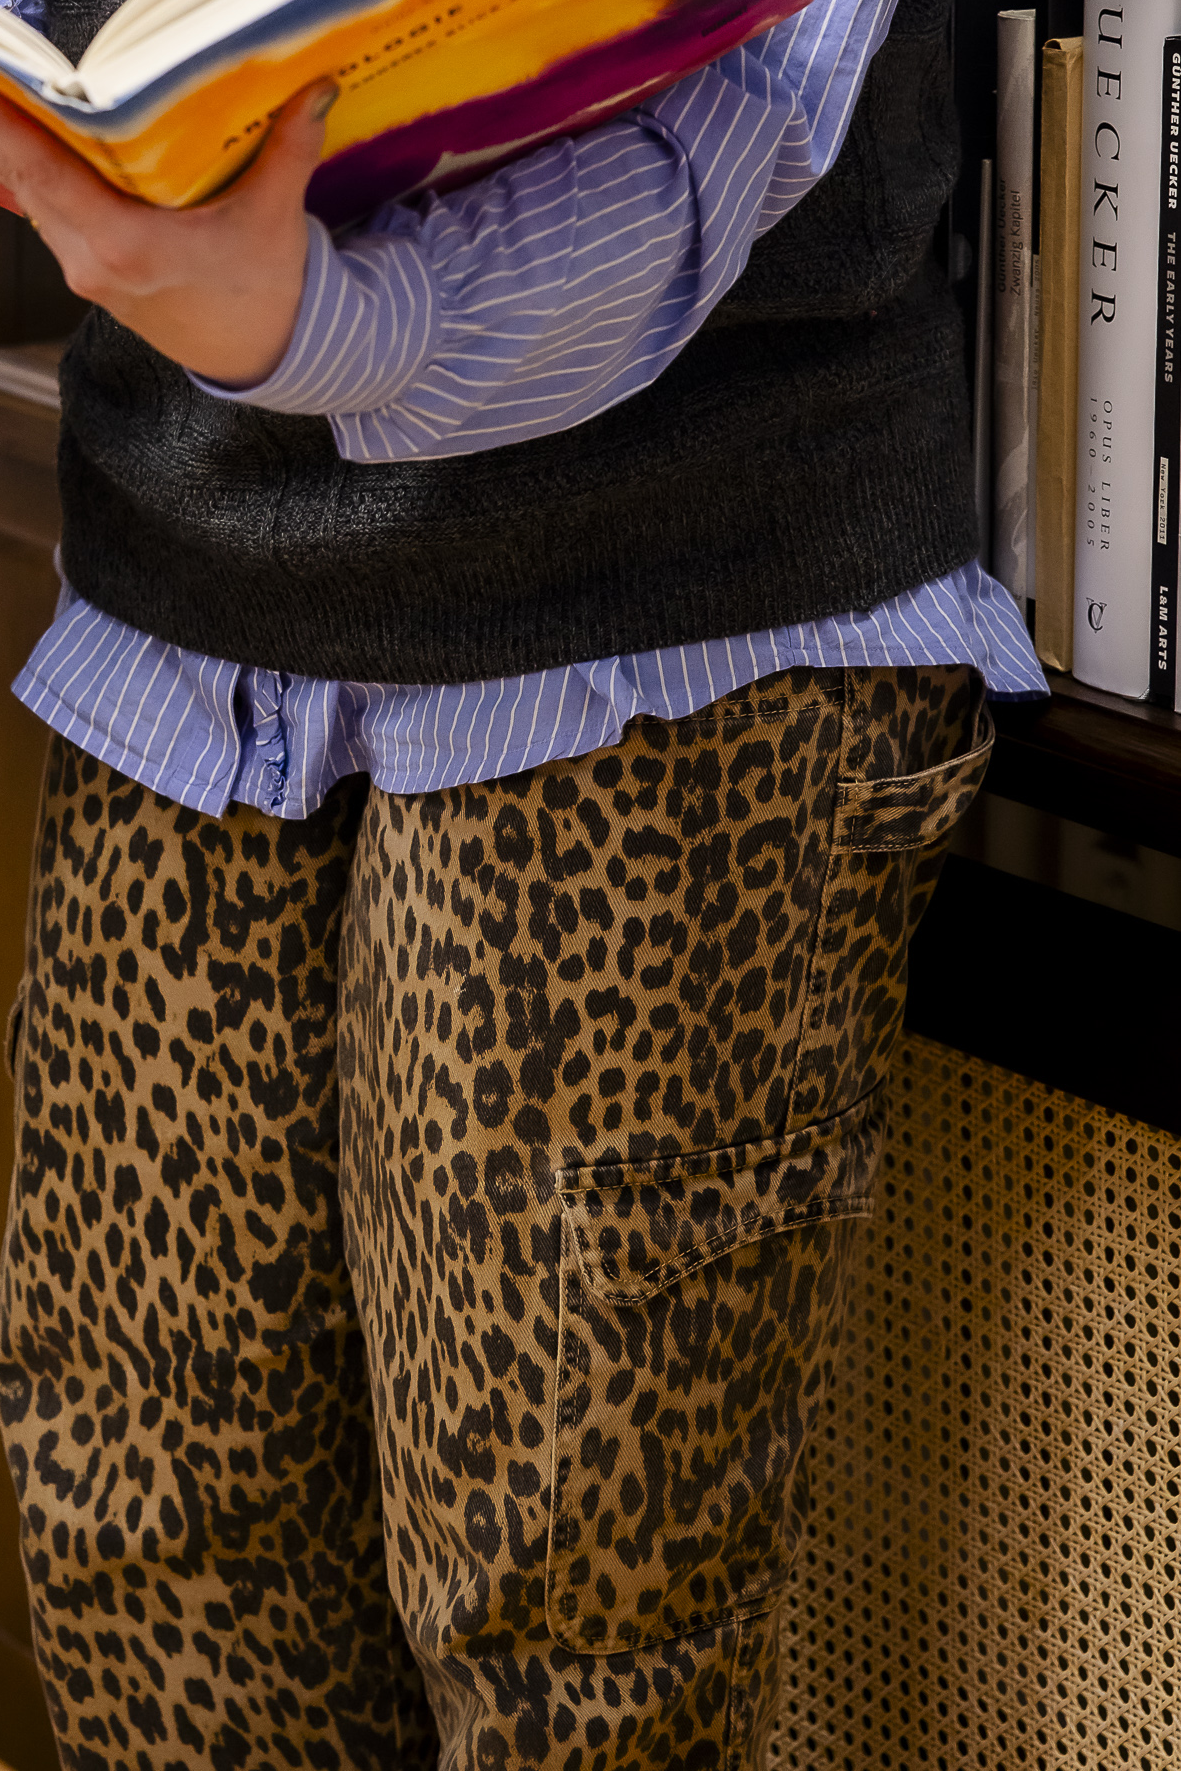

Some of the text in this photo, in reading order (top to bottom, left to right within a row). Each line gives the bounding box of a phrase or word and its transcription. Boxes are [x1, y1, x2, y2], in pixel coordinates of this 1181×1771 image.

[1008, 189, 1024, 296] Zwanzig Kapitel
[1090, 6, 1124, 326] UECKER
[1157, 52, 1181, 671] GÜNTHER UECKER THE EARLY YEARS L&M ARTS
[1099, 399, 1113, 552] OPUS LIBER
[1158, 462, 1167, 540] New York 2011
